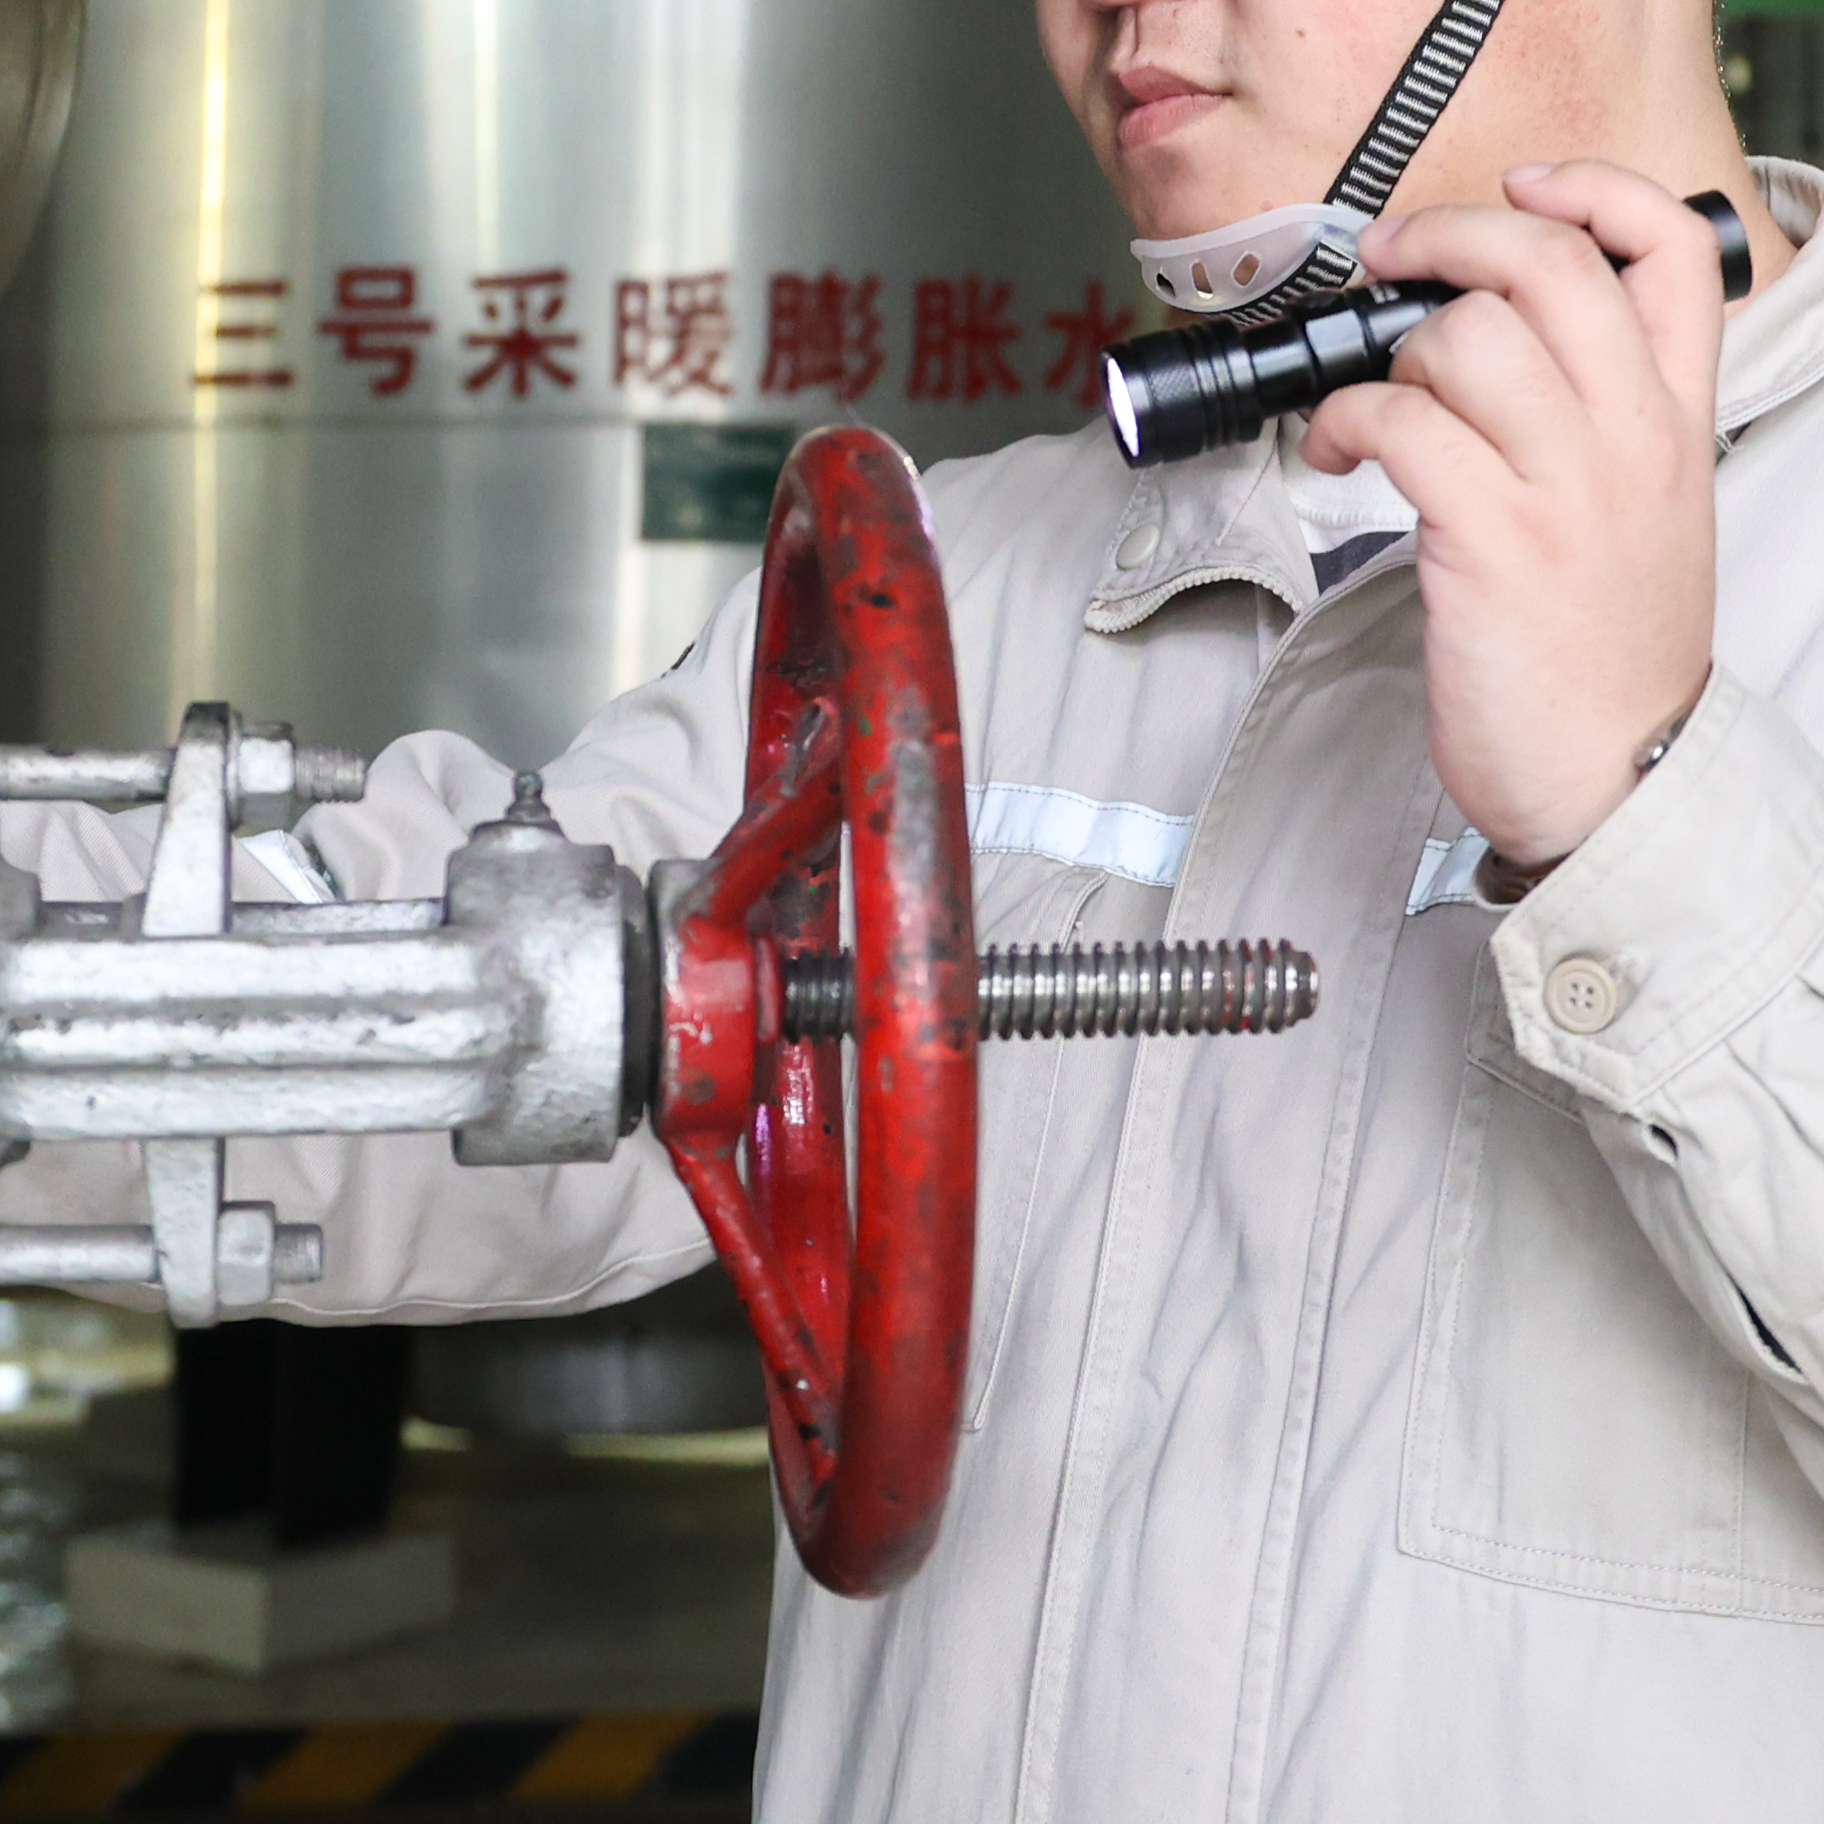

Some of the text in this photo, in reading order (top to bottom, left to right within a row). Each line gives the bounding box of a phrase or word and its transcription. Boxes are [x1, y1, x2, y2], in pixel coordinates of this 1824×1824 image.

[186, 262, 1138, 409] 三号采暖膨胀水
